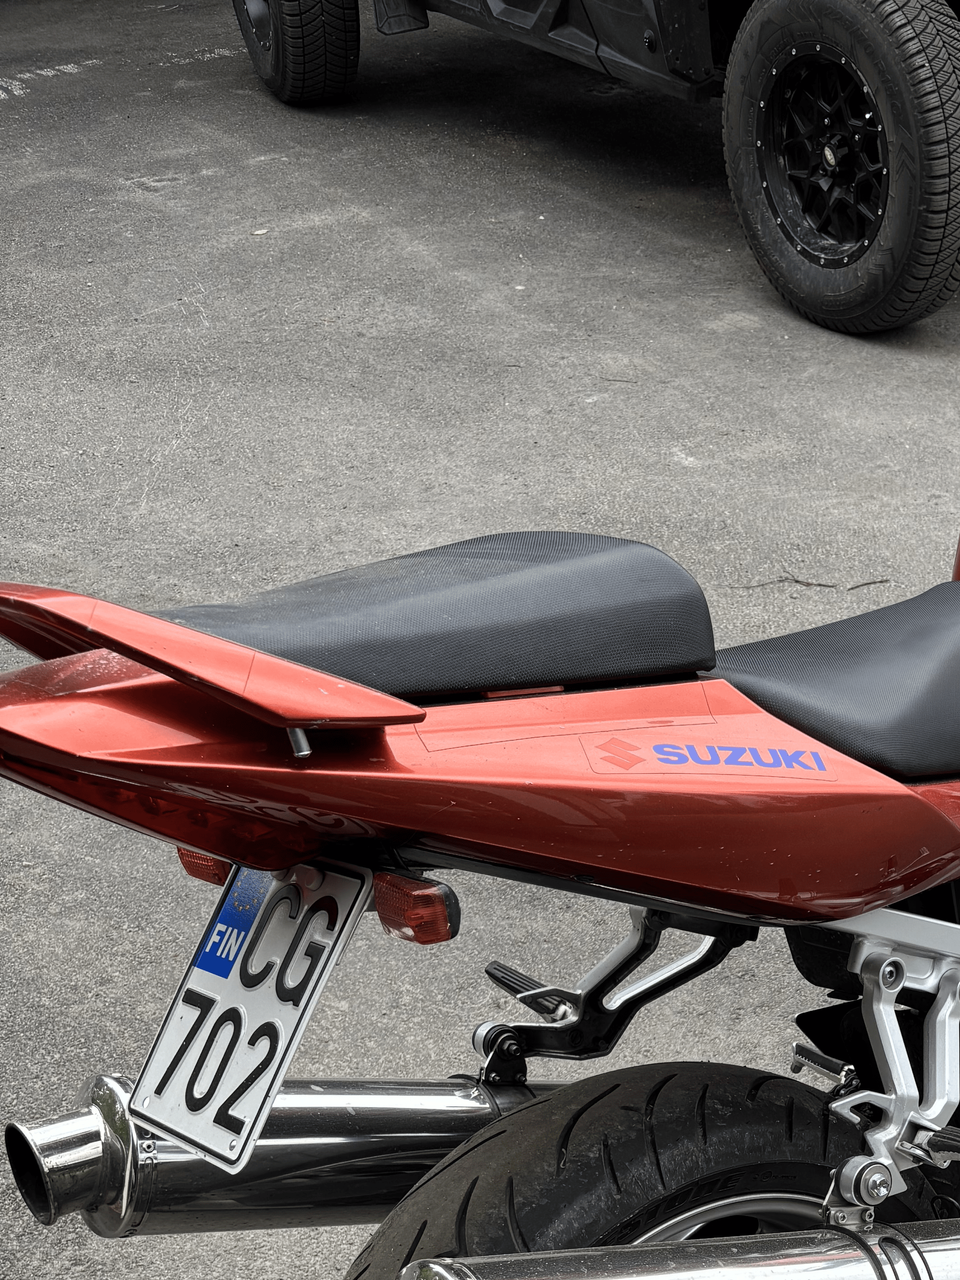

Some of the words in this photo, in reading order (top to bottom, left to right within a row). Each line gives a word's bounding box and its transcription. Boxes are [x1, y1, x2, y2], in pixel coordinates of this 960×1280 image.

[652, 743, 827, 772] SUZUKI
[205, 923, 245, 961] FIN
[240, 885, 338, 1008] CG
[154, 988, 279, 1136] 702
